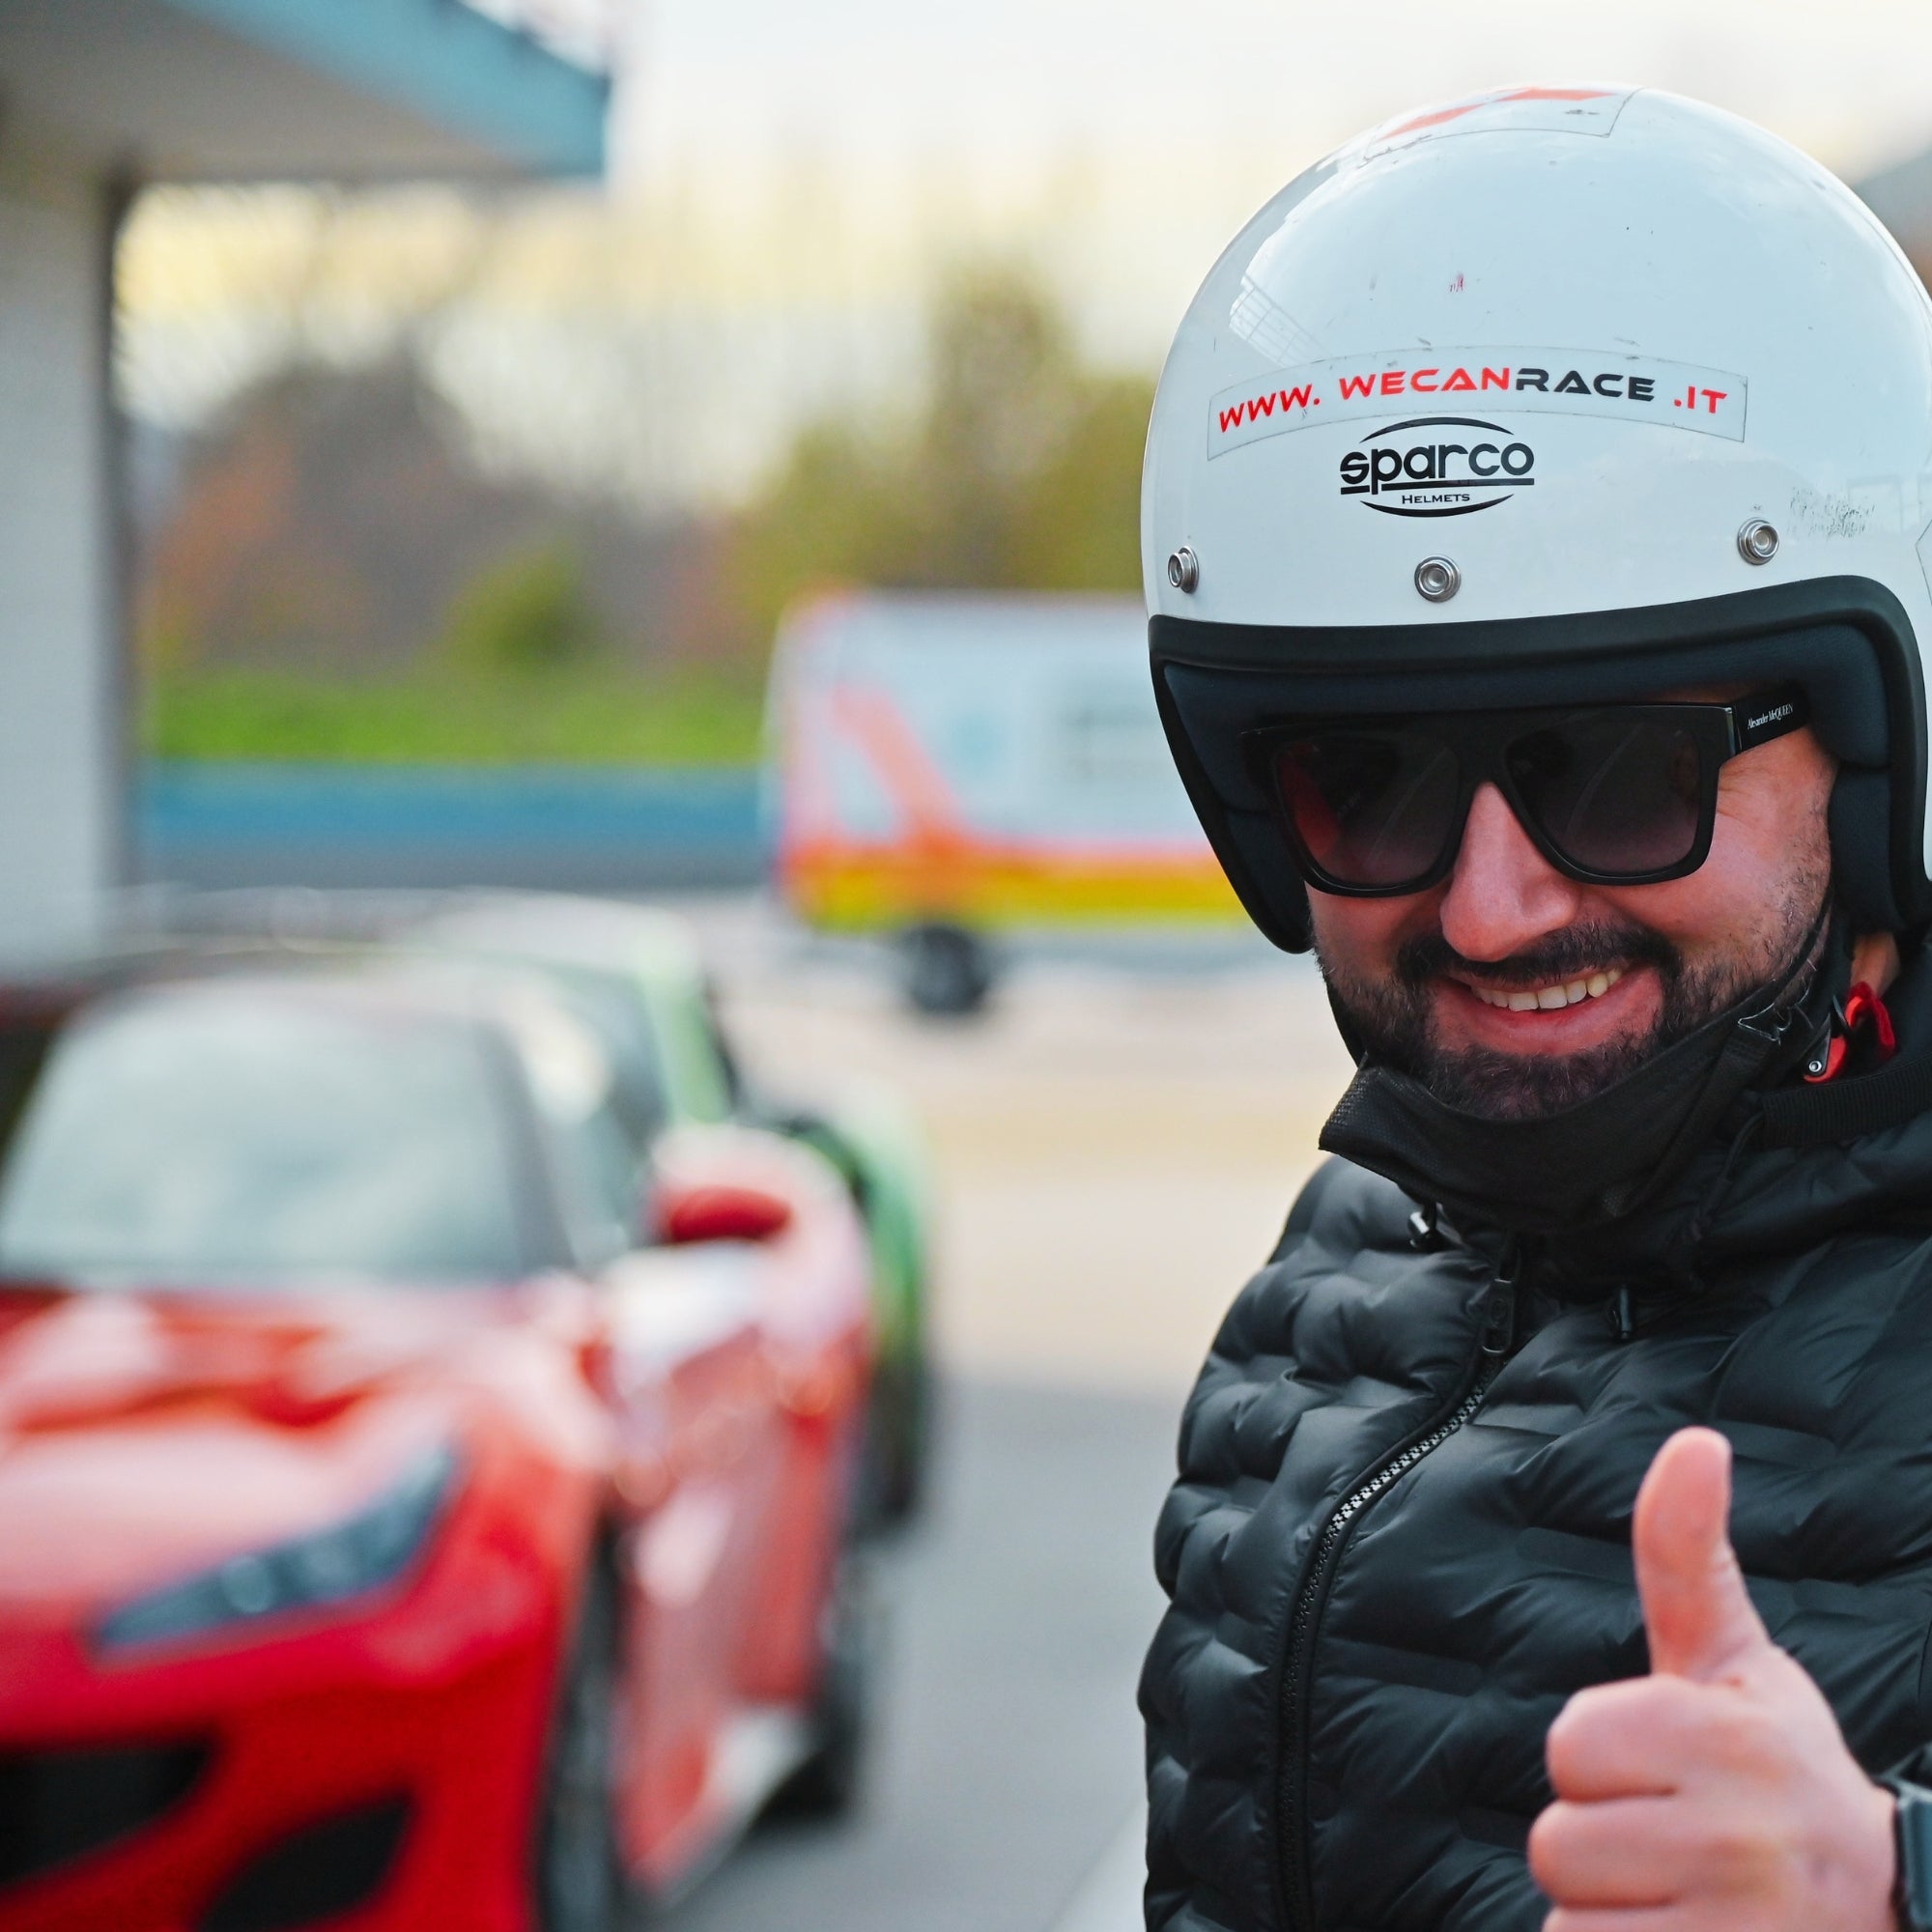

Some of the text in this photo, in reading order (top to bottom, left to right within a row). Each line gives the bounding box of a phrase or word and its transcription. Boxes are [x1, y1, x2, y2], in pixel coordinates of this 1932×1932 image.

[1218, 367, 1728, 433] WWW. WECANRACE .IT
[1340, 441, 1535, 496] sparco
